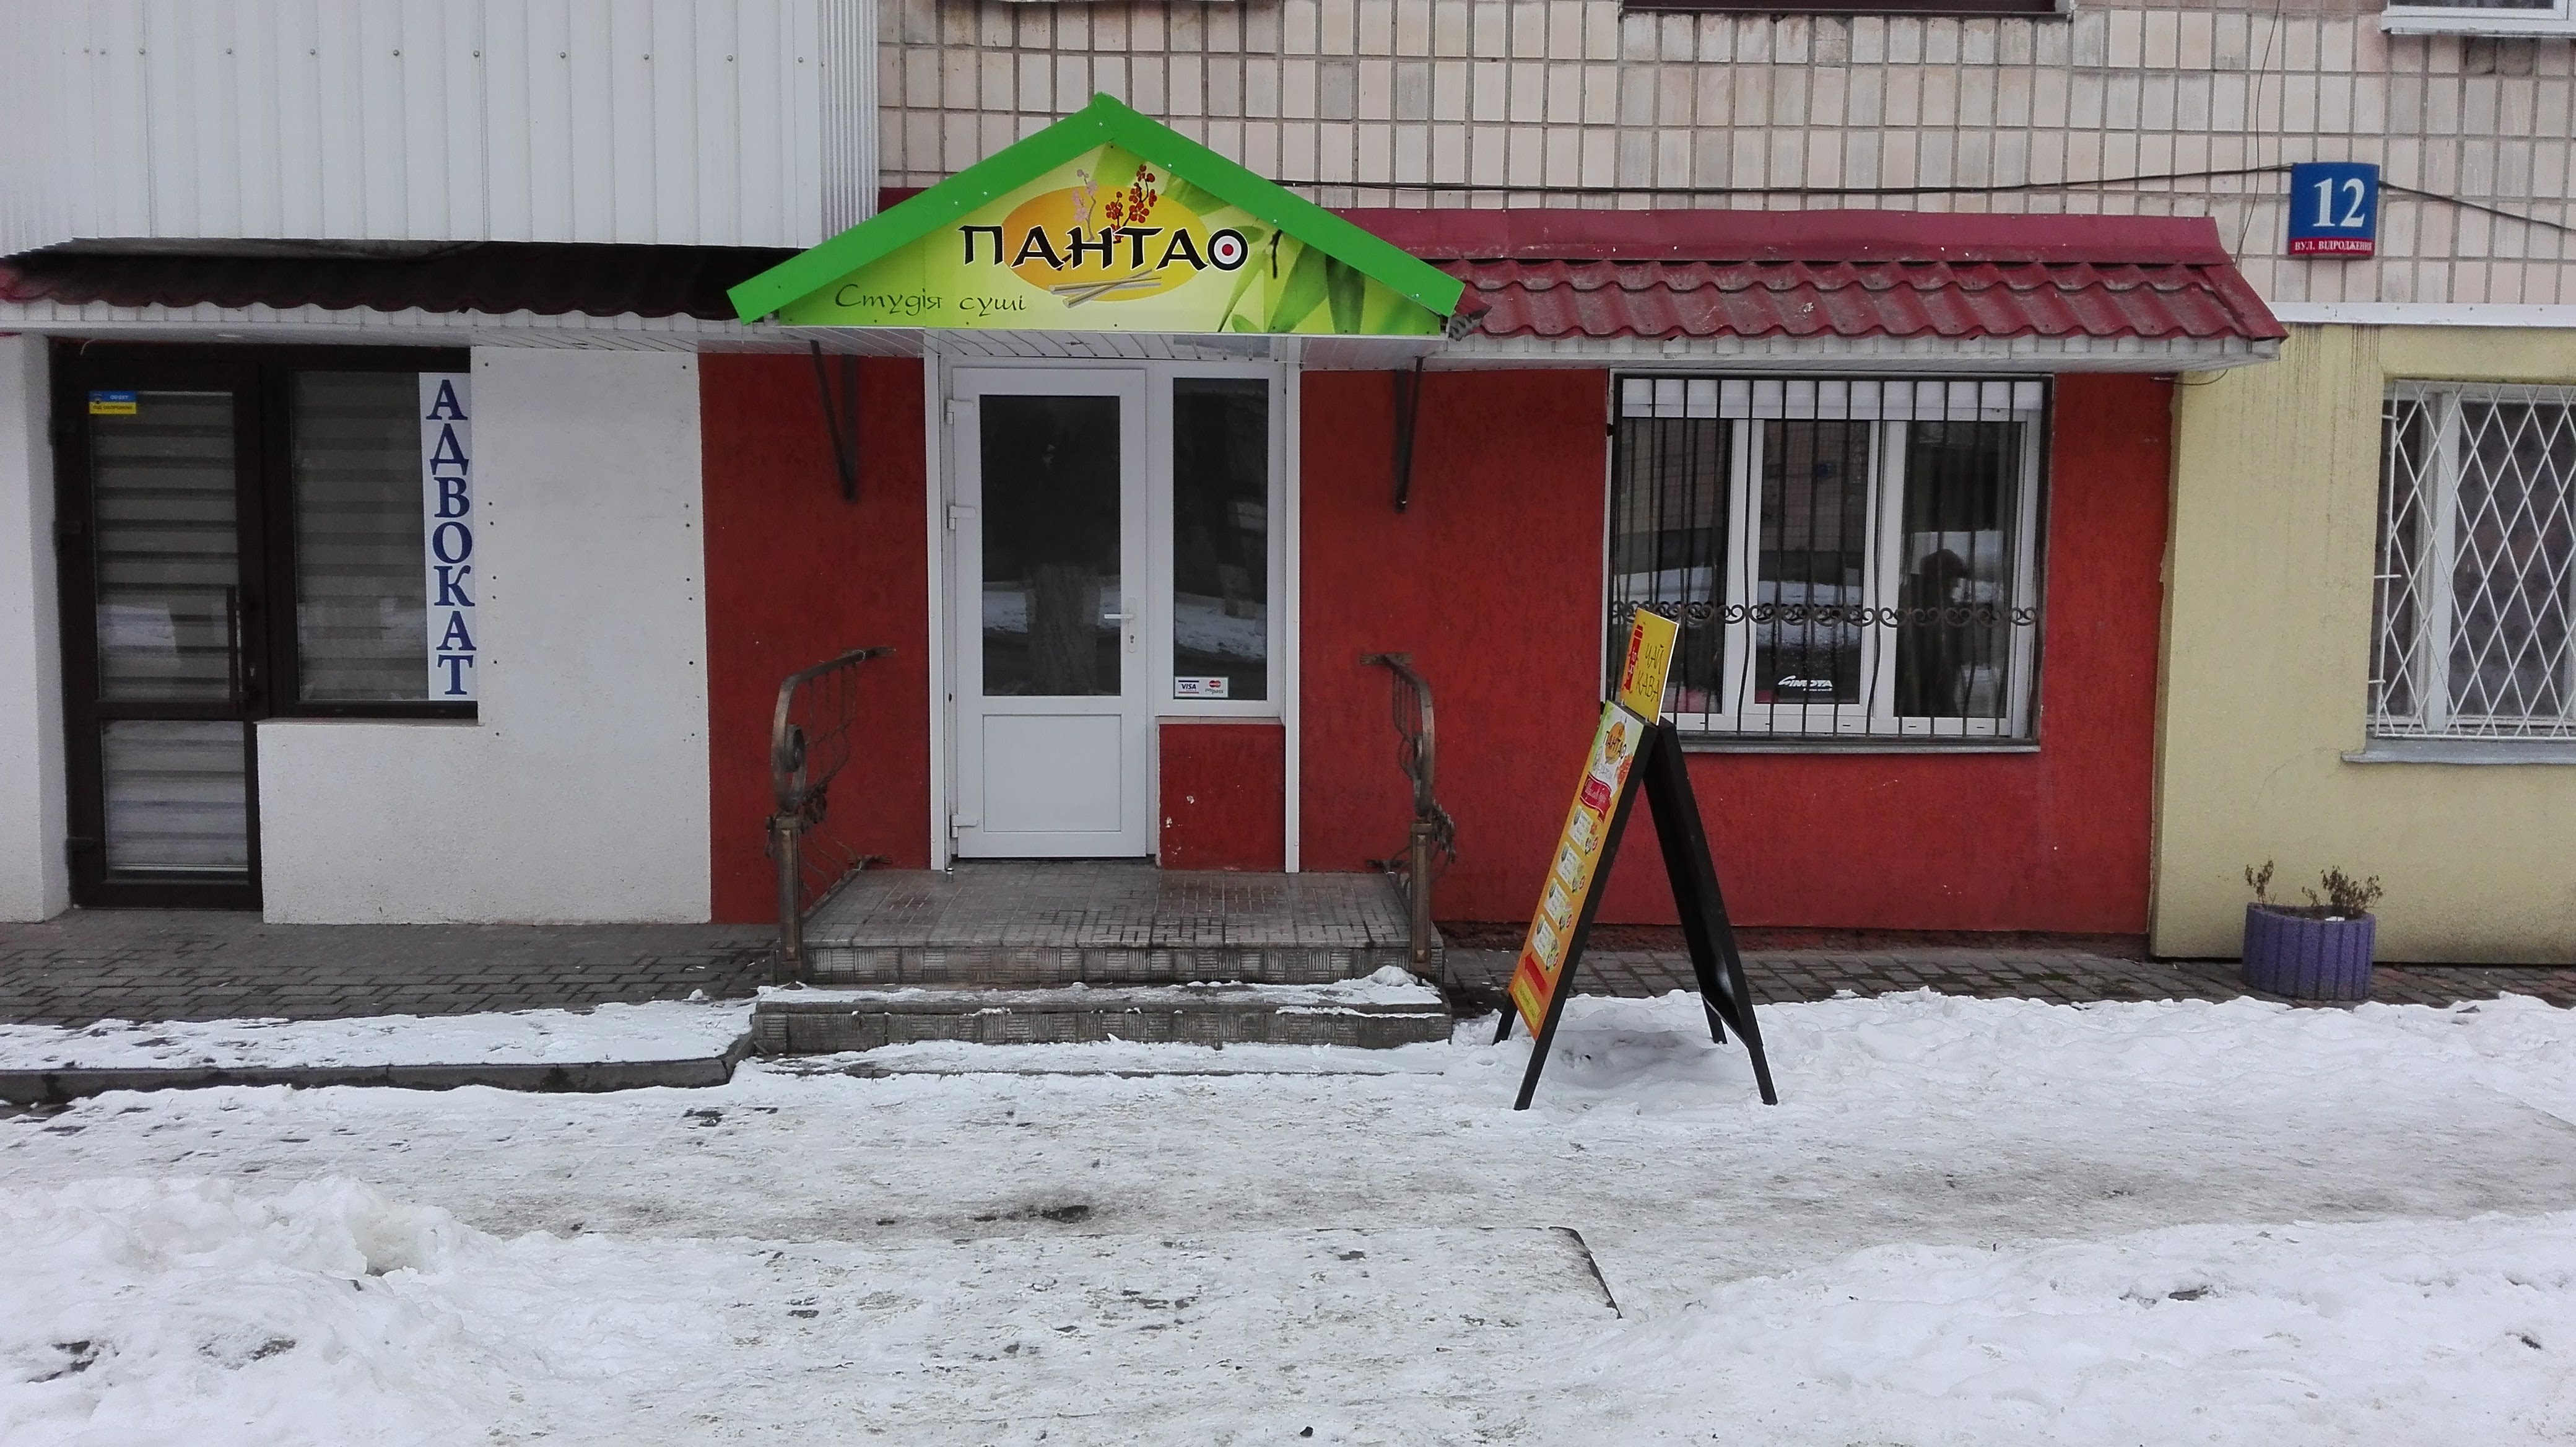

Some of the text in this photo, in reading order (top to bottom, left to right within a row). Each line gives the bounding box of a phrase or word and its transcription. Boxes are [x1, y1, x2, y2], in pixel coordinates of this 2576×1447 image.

[2313, 177, 2365, 227] 12
[958, 225, 1249, 271] ПАНТАО
[2295, 241, 2315, 250] ВУЛ.
[836, 284, 1026, 317] Студія суші
[426, 379, 477, 695] АДВОКАТ
[1645, 642, 1664, 675] ЧАЙ
[1635, 670, 1660, 702] КАВА
